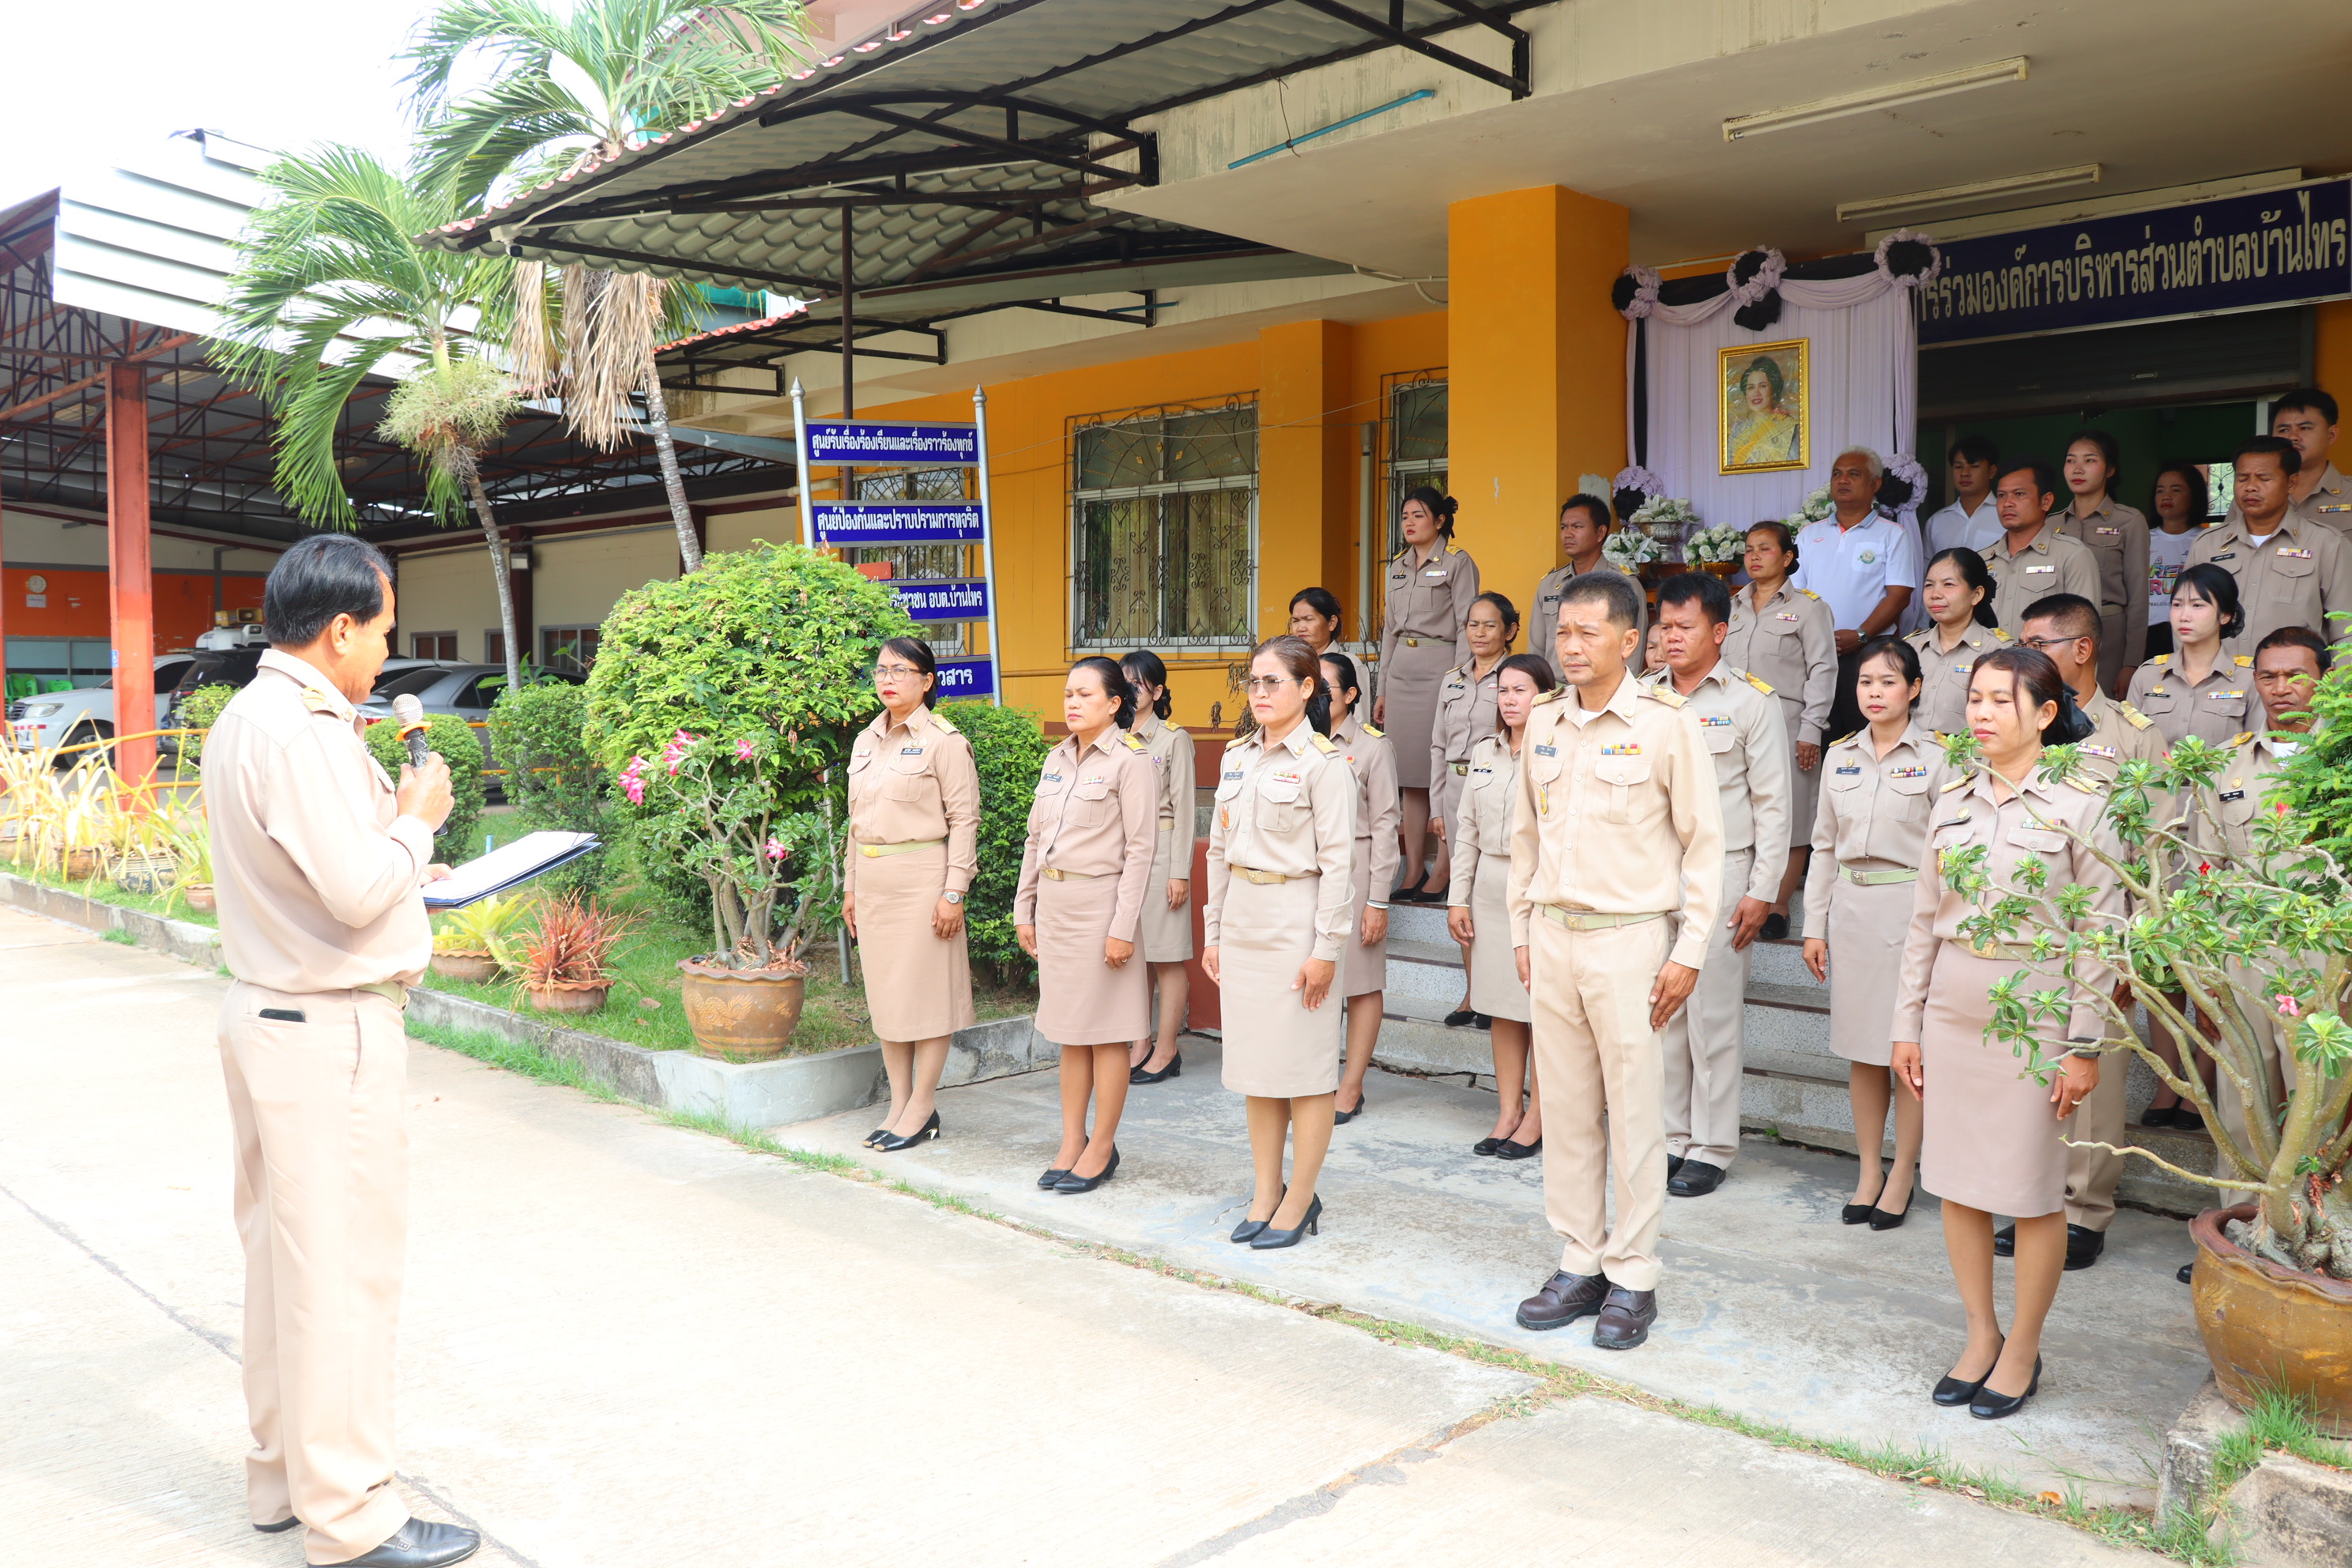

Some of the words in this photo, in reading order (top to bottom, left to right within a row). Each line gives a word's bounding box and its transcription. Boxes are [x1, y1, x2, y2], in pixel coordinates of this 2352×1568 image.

[812, 424, 974, 459] ศูนย์รับเรื่องร้องเรียนและเรื่องราวร้องทุกข์
[817, 505, 979, 541] ศูนย์ป้องกันและปราบปรามการทุจริต
